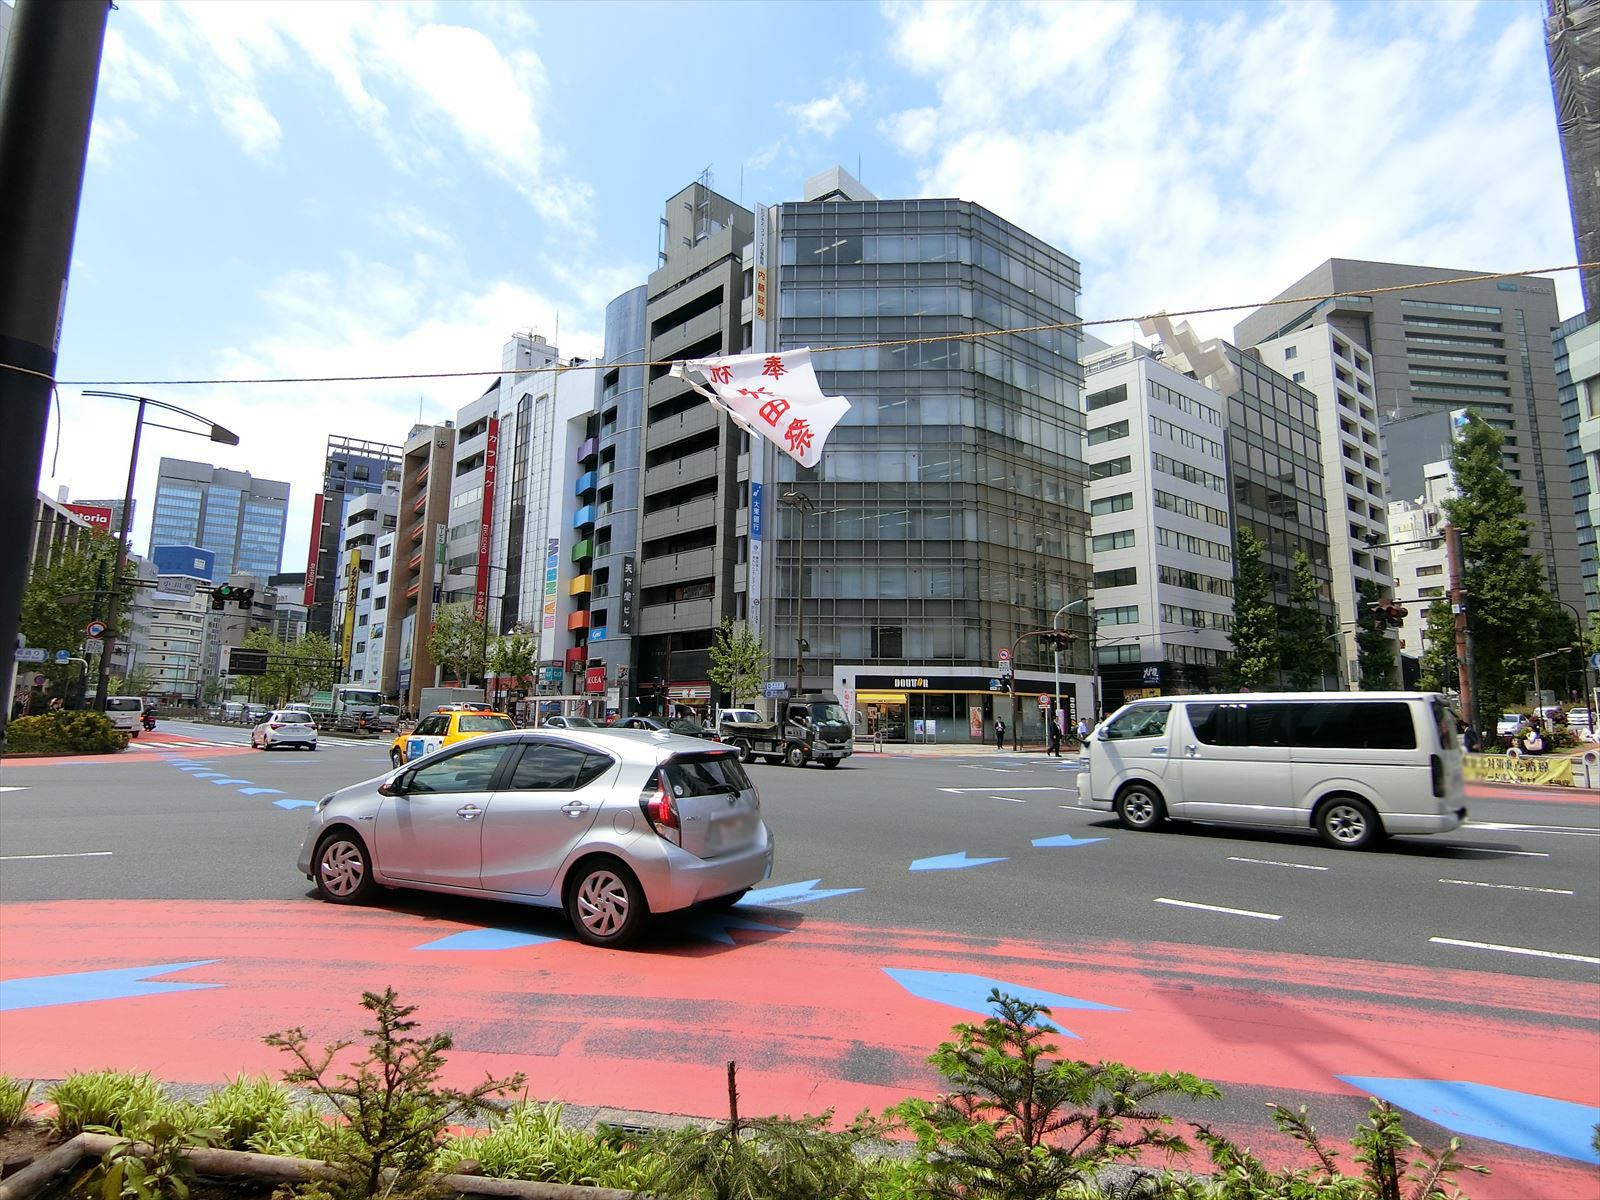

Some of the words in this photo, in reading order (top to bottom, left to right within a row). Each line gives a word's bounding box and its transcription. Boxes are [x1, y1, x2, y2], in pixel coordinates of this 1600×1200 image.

[757, 271, 765, 317] 内藤証券
[485, 435, 497, 488] カラオケ
[307, 562, 316, 587] Victoria
[543, 538, 560, 629] RAINBOW
[894, 678, 929, 688] DOUTOR
